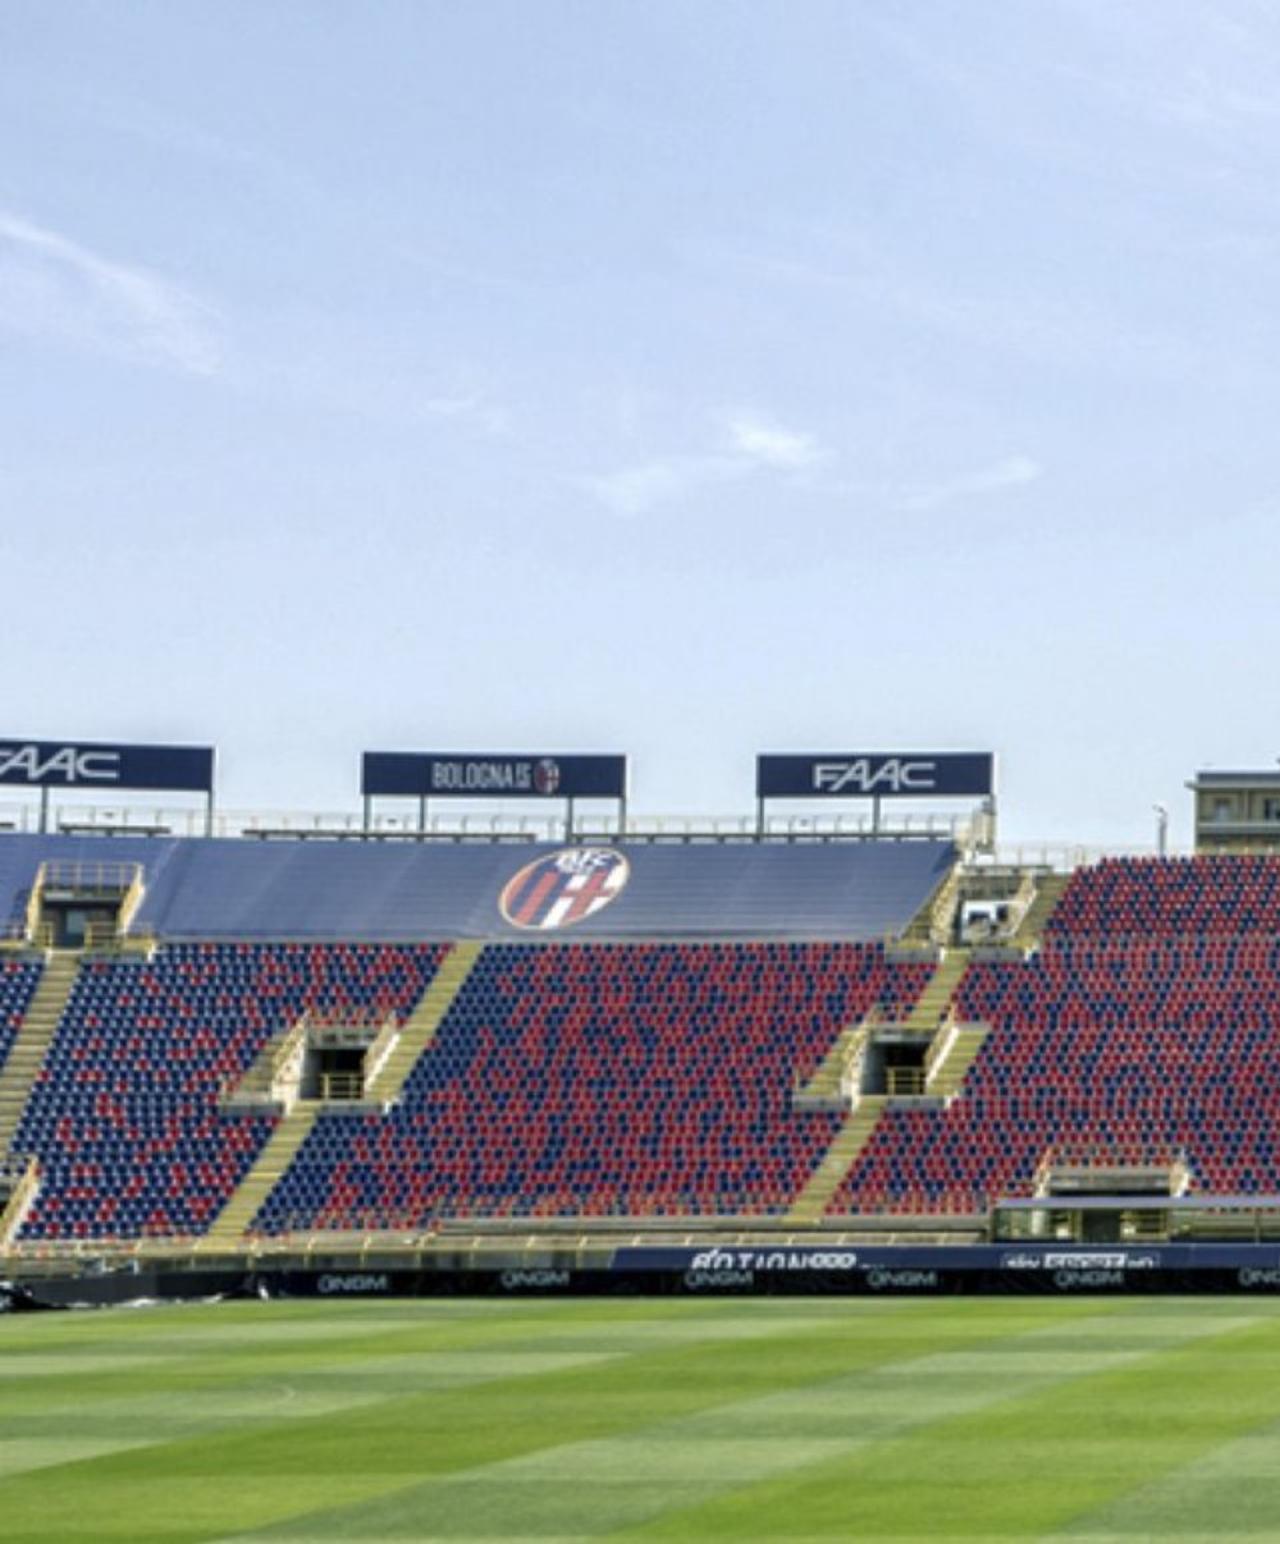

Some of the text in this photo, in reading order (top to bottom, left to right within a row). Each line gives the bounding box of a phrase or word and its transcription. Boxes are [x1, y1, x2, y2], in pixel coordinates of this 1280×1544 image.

[0, 745, 120, 782] AAC
[432, 762, 514, 788] BOLOGNA
[813, 758, 935, 792] FAAC
